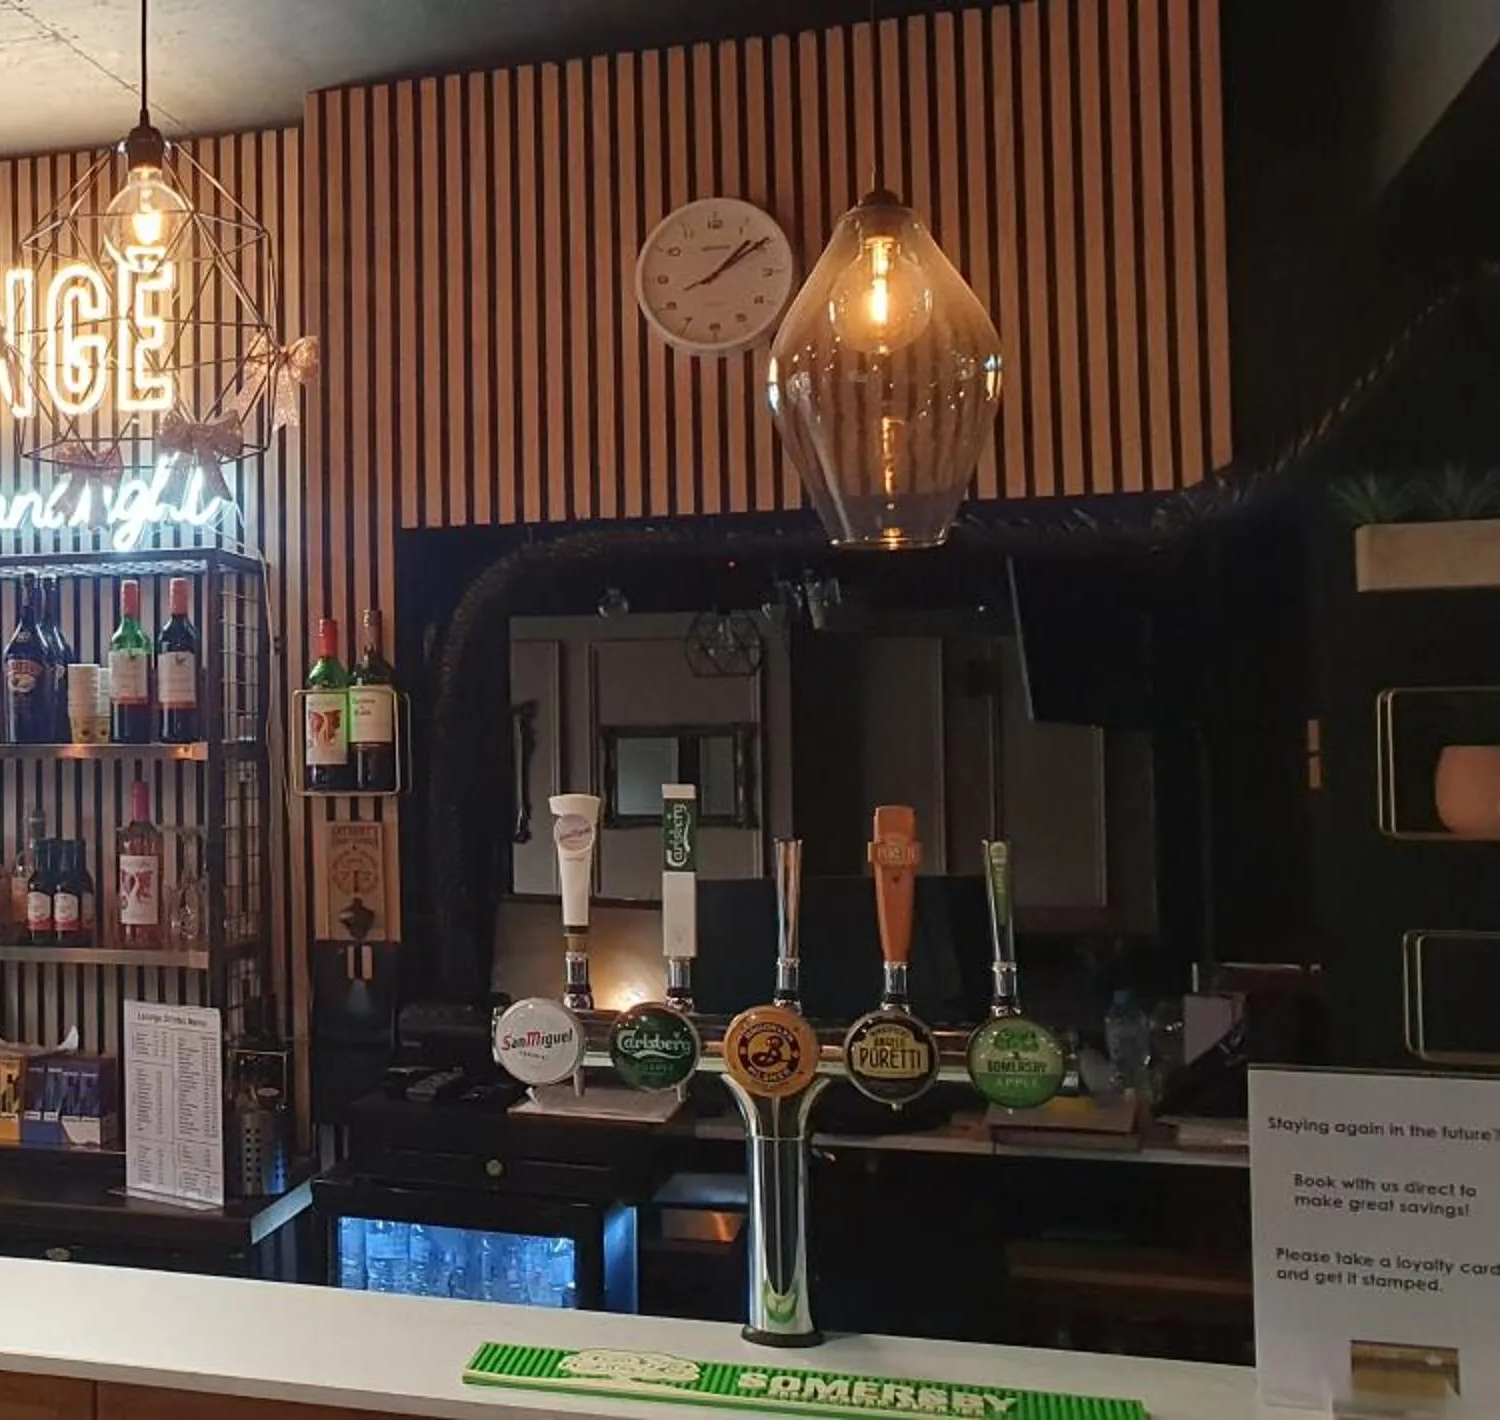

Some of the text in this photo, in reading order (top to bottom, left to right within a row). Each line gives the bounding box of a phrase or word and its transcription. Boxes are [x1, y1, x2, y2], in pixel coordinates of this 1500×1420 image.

[665, 803, 692, 868] Carlsberg
[616, 1028, 693, 1058] Carlsberg
[1268, 1116, 1329, 1135] Staying
[1334, 1121, 1384, 1137] again
[1389, 1122, 1405, 1136] in
[1409, 1123, 1437, 1138] the
[1294, 1173, 1477, 1198] Book with us direct to
[1295, 1195, 1470, 1219] make great savings!
[1276, 1247, 1330, 1264] Please
[1335, 1251, 1374, 1267] take
[1379, 1258, 1391, 1269] a
[1396, 1256, 1455, 1275] loyalty
[1277, 1269, 1443, 1293] and get it stamped.
[738, 1372, 1017, 1418] SOMERSBY
